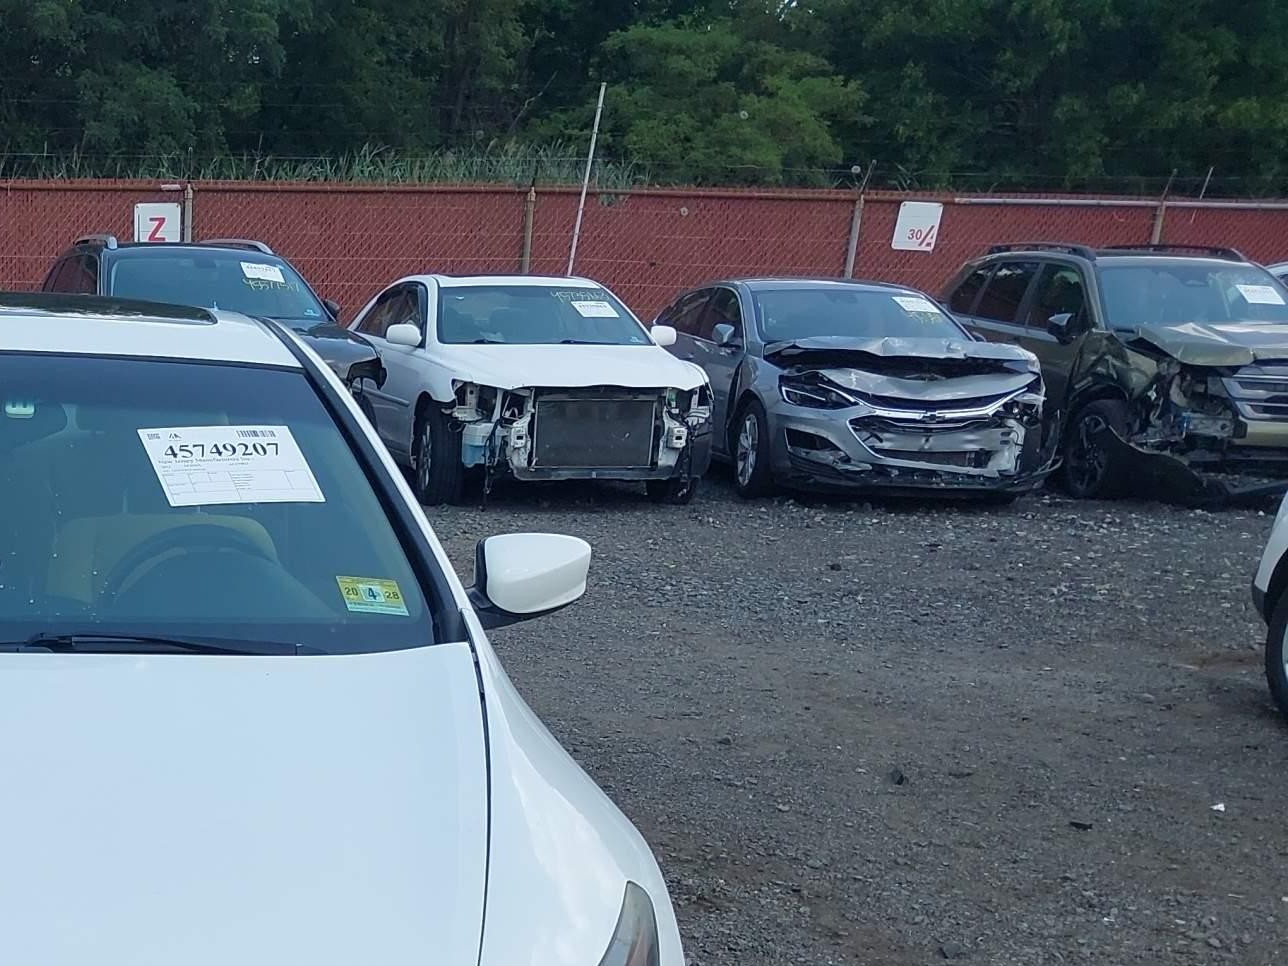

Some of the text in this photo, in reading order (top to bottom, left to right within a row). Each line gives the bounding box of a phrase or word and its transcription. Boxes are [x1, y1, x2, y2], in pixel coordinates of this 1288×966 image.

[148, 217, 166, 242] Z
[164, 442, 279, 458] 45749207
[344, 586, 400, 601] 20 4 28
